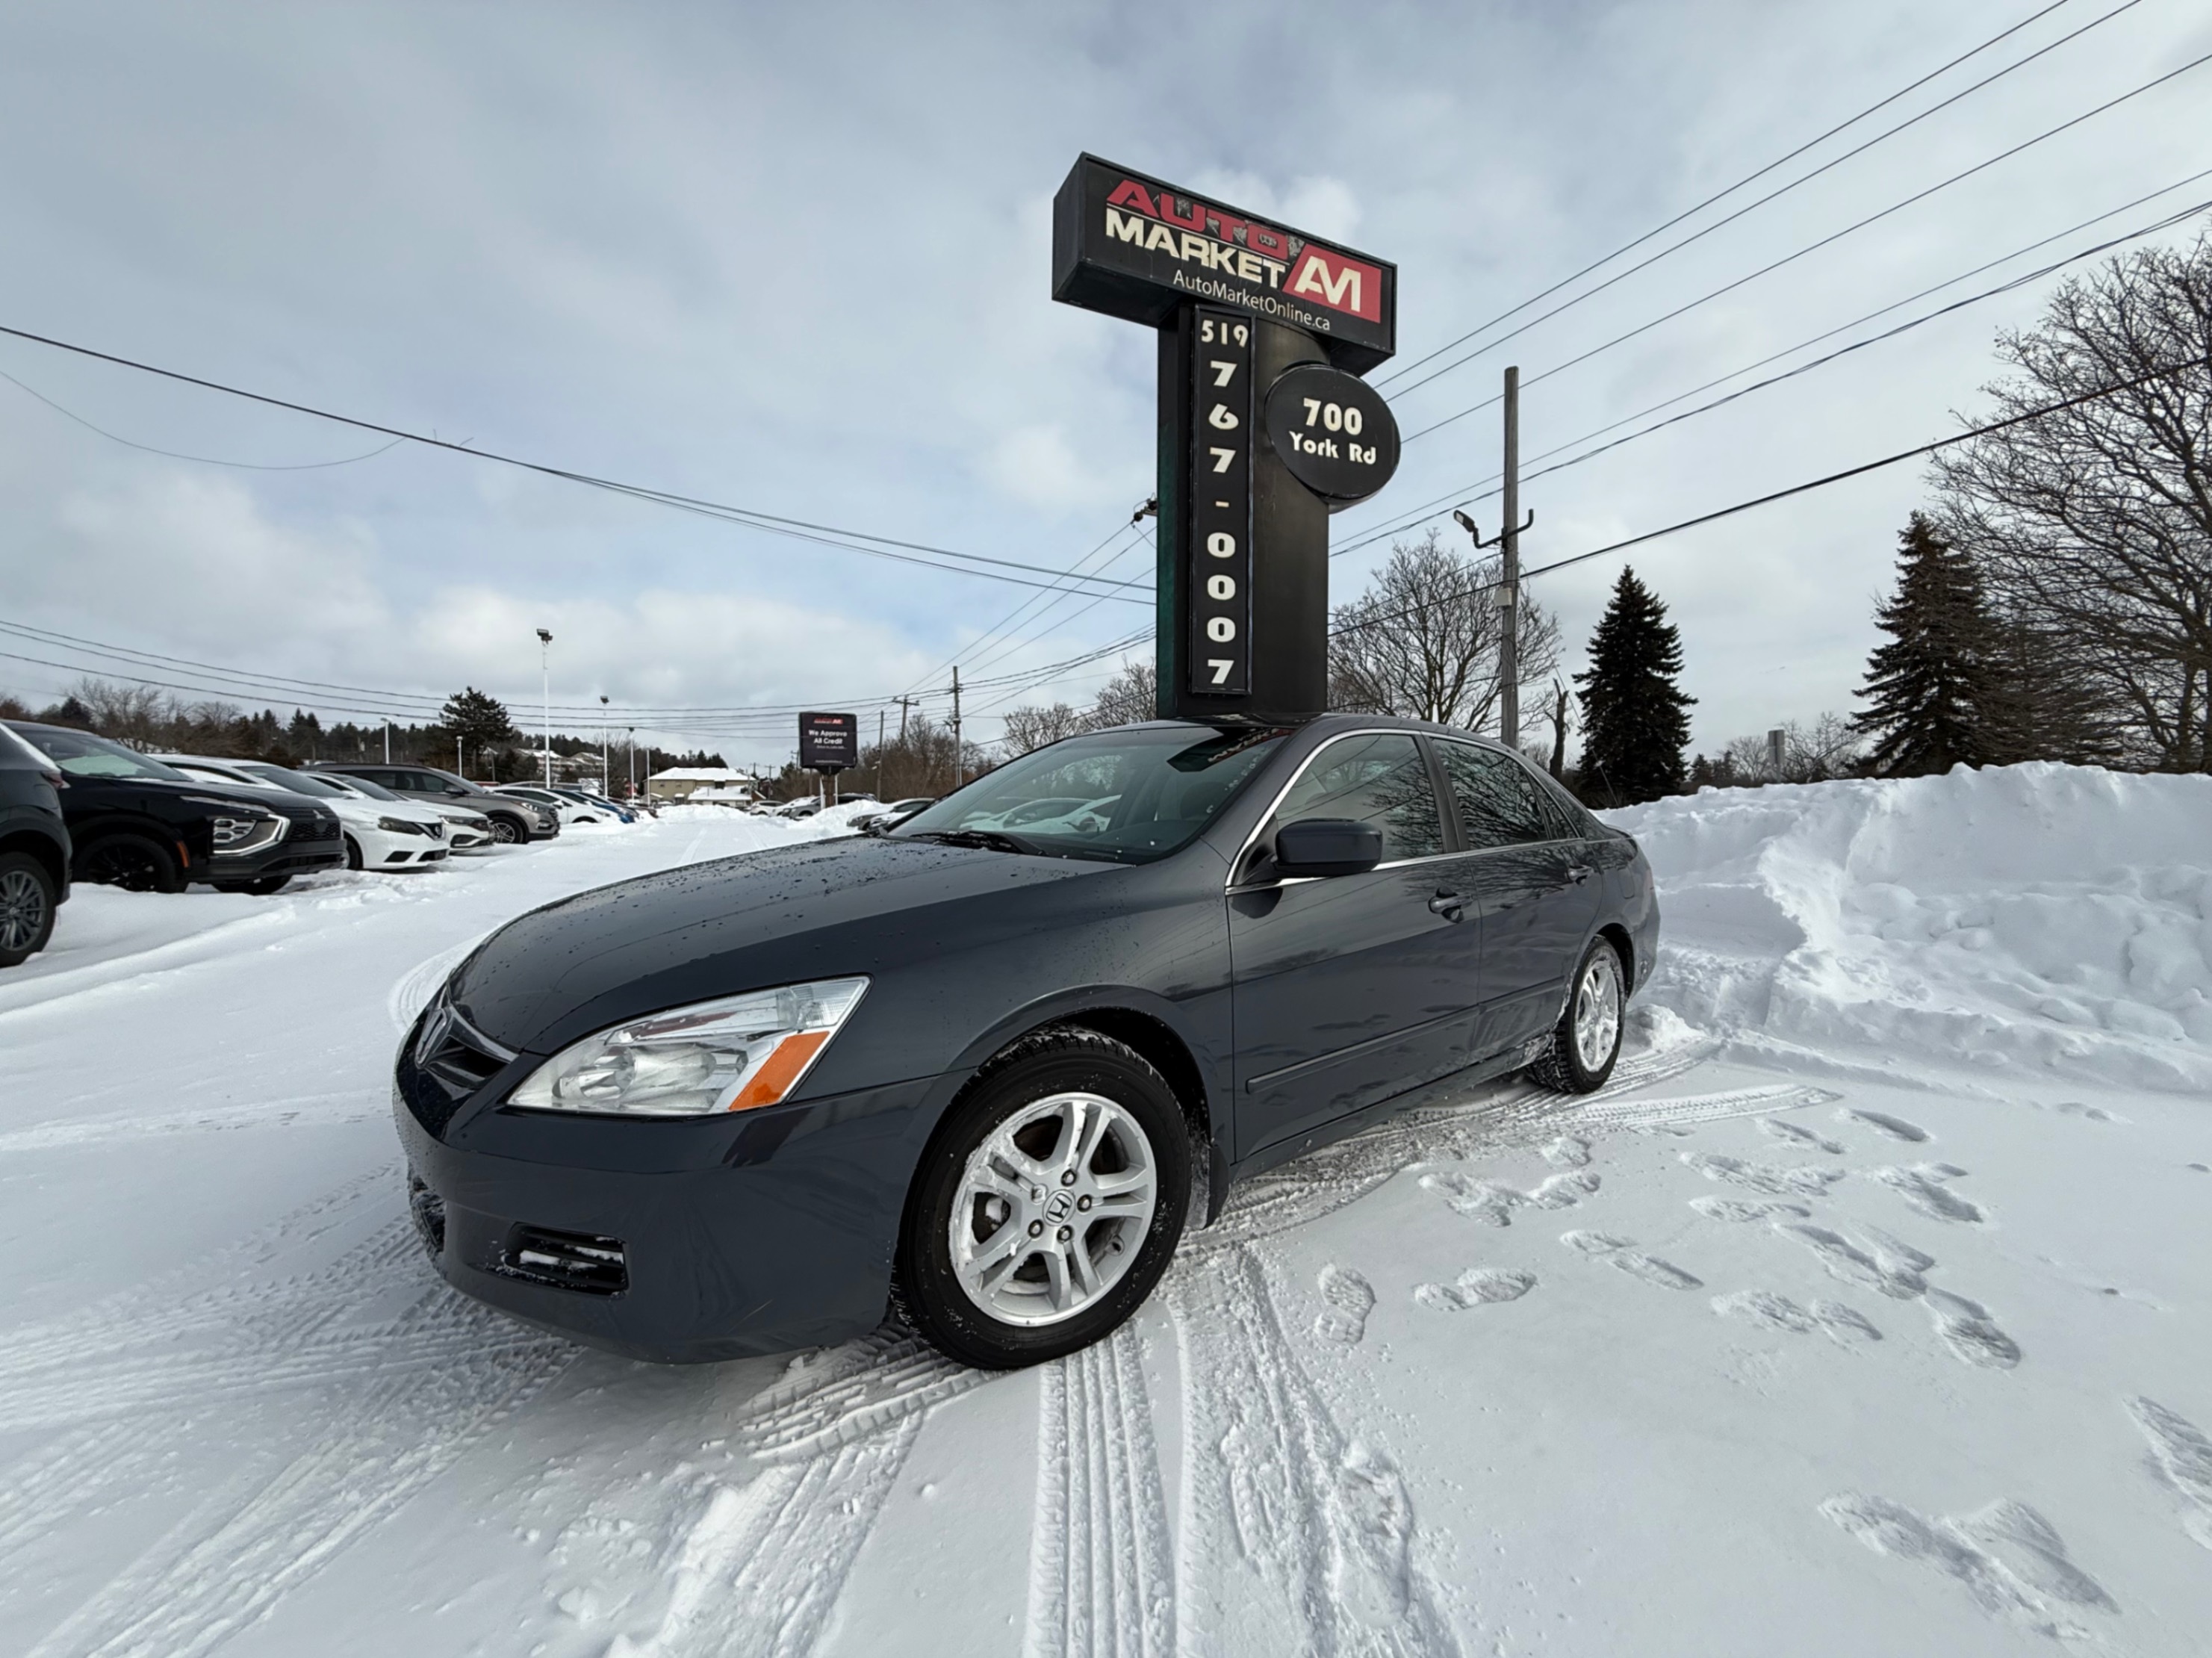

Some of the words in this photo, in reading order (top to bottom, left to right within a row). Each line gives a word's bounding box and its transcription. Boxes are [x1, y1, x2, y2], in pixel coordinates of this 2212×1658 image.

[1106, 180, 1289, 260] AUTO
[1106, 207, 1285, 288] MARKET
[1172, 270, 1331, 331] AutoMarketOnline.ca
[1201, 320, 1249, 347] 519
[1303, 397, 1363, 435] 700
[1288, 431, 1339, 459] York
[1349, 444, 1377, 465] Rd
